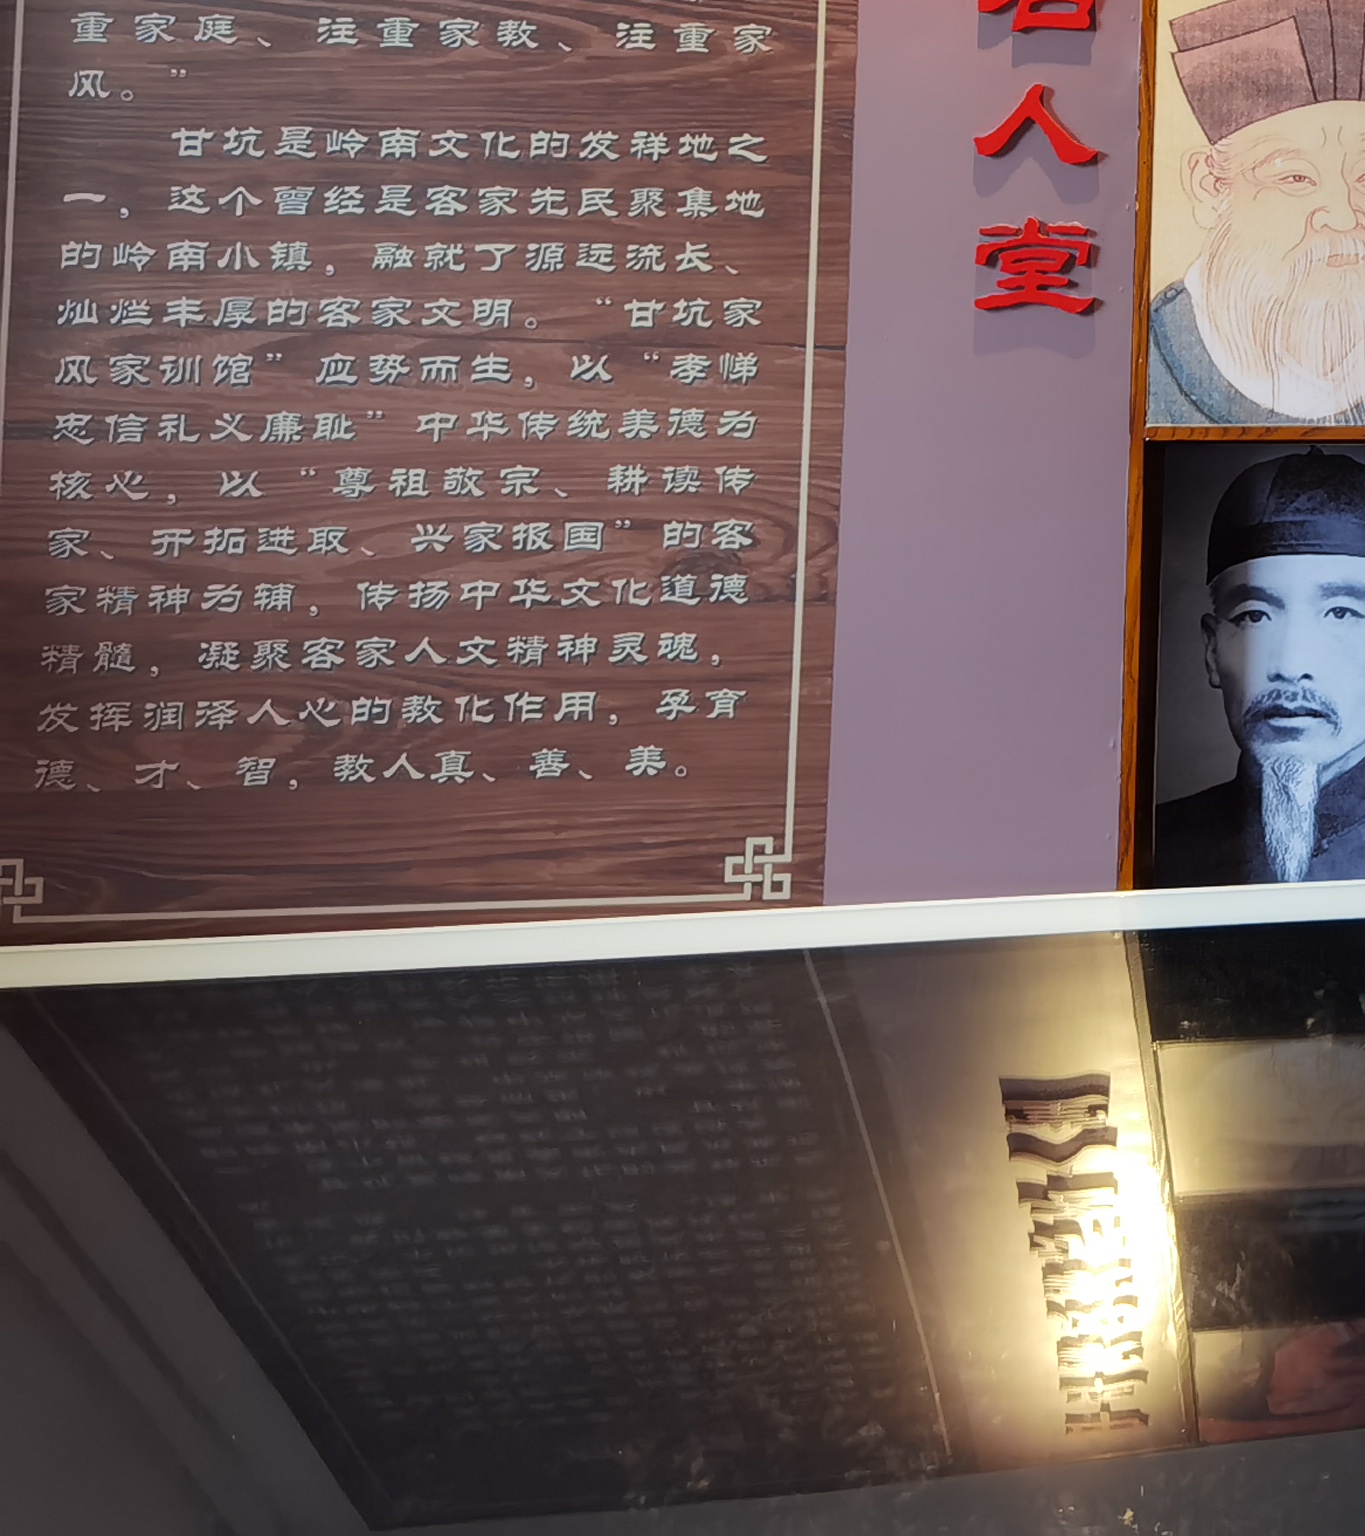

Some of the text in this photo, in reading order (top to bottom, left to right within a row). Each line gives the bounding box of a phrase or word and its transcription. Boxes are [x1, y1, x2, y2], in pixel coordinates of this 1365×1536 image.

[171, 125, 769, 165] 甘坑是岭南文化的发祥地之
